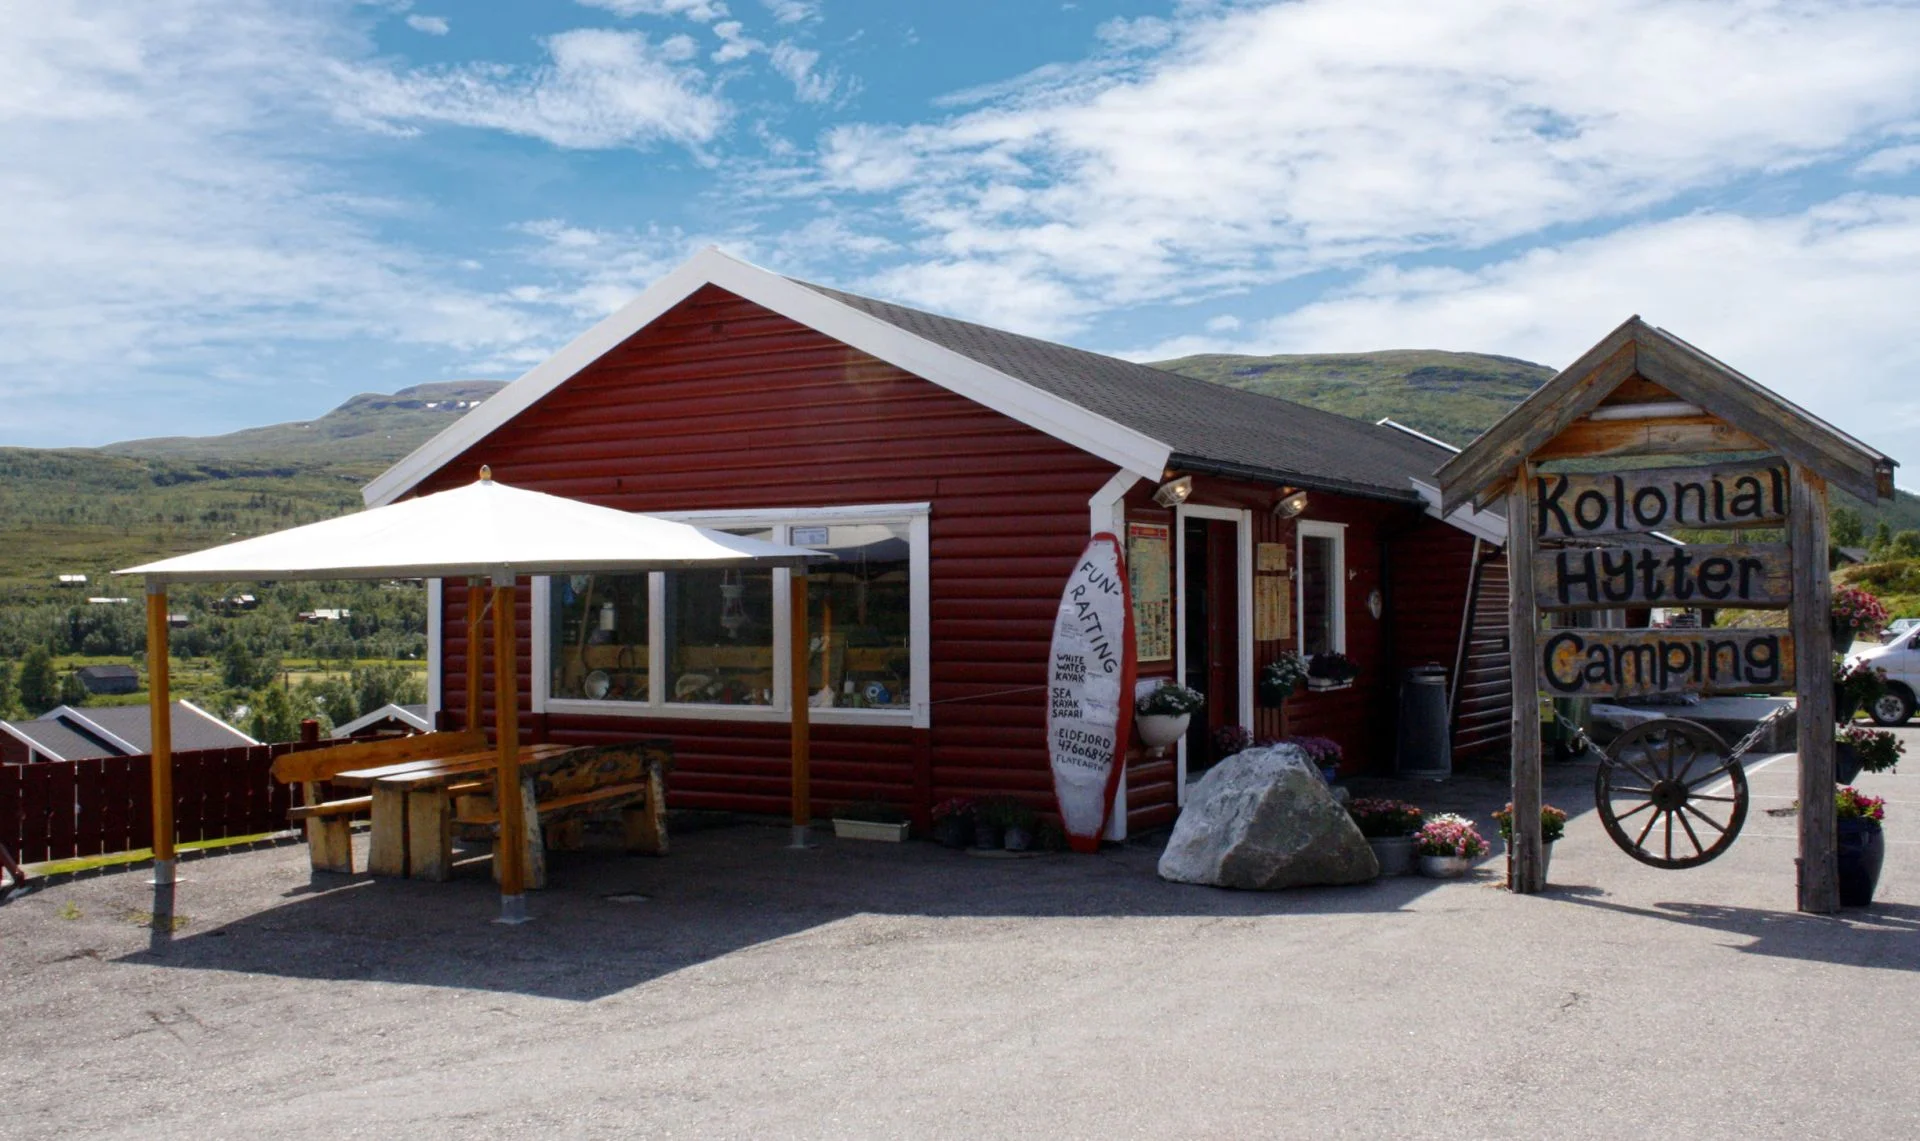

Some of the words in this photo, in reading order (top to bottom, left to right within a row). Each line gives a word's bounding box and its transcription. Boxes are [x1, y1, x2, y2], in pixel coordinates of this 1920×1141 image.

[1537, 467, 1786, 537] Kolonial
[1556, 548, 1763, 604] Hytter
[1070, 584, 1118, 673] RAFTING
[1056, 653, 1085, 665] WHITE
[1543, 632, 1779, 692] Camping
[1056, 663, 1087, 674] WATER
[1055, 671, 1086, 683] KAYAK
[1052, 687, 1072, 698] SEA
[1052, 698, 1080, 709] KAYAK
[1052, 708, 1083, 719] SAFARI
[1059, 728, 1111, 750] EIDFJORD
